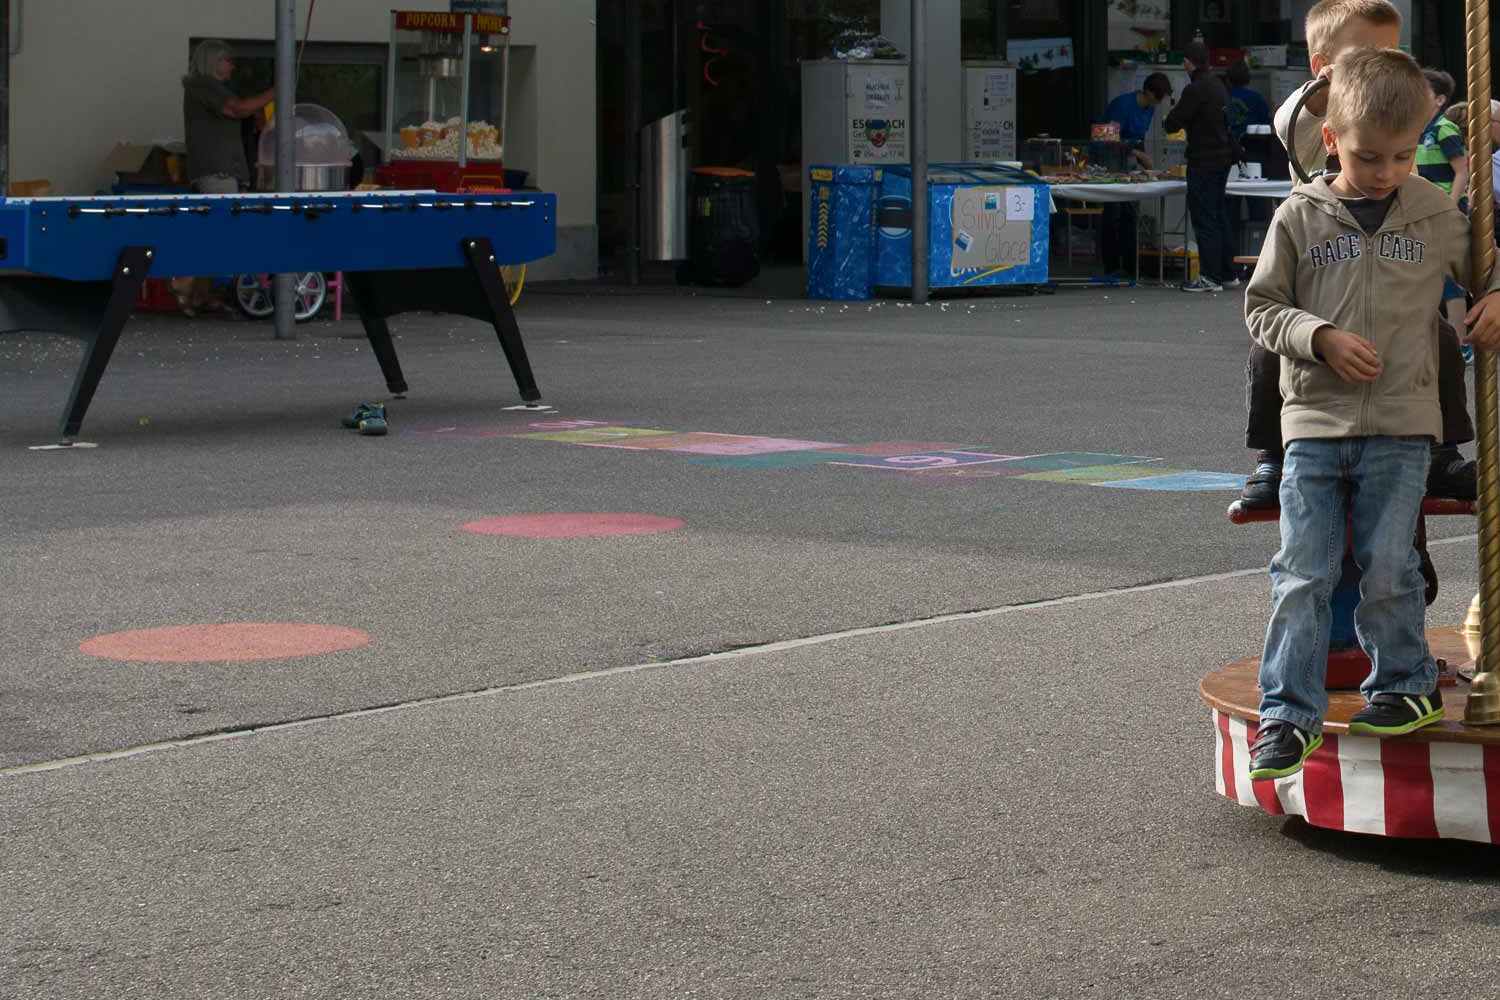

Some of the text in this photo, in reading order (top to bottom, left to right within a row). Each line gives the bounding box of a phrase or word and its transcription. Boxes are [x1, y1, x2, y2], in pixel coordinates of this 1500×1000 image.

[406, 13, 457, 27] POPCORN
[852, 119, 905, 129] ESACH
[985, 231, 1027, 264] Glace
[1308, 233, 1425, 268] RACE CART
